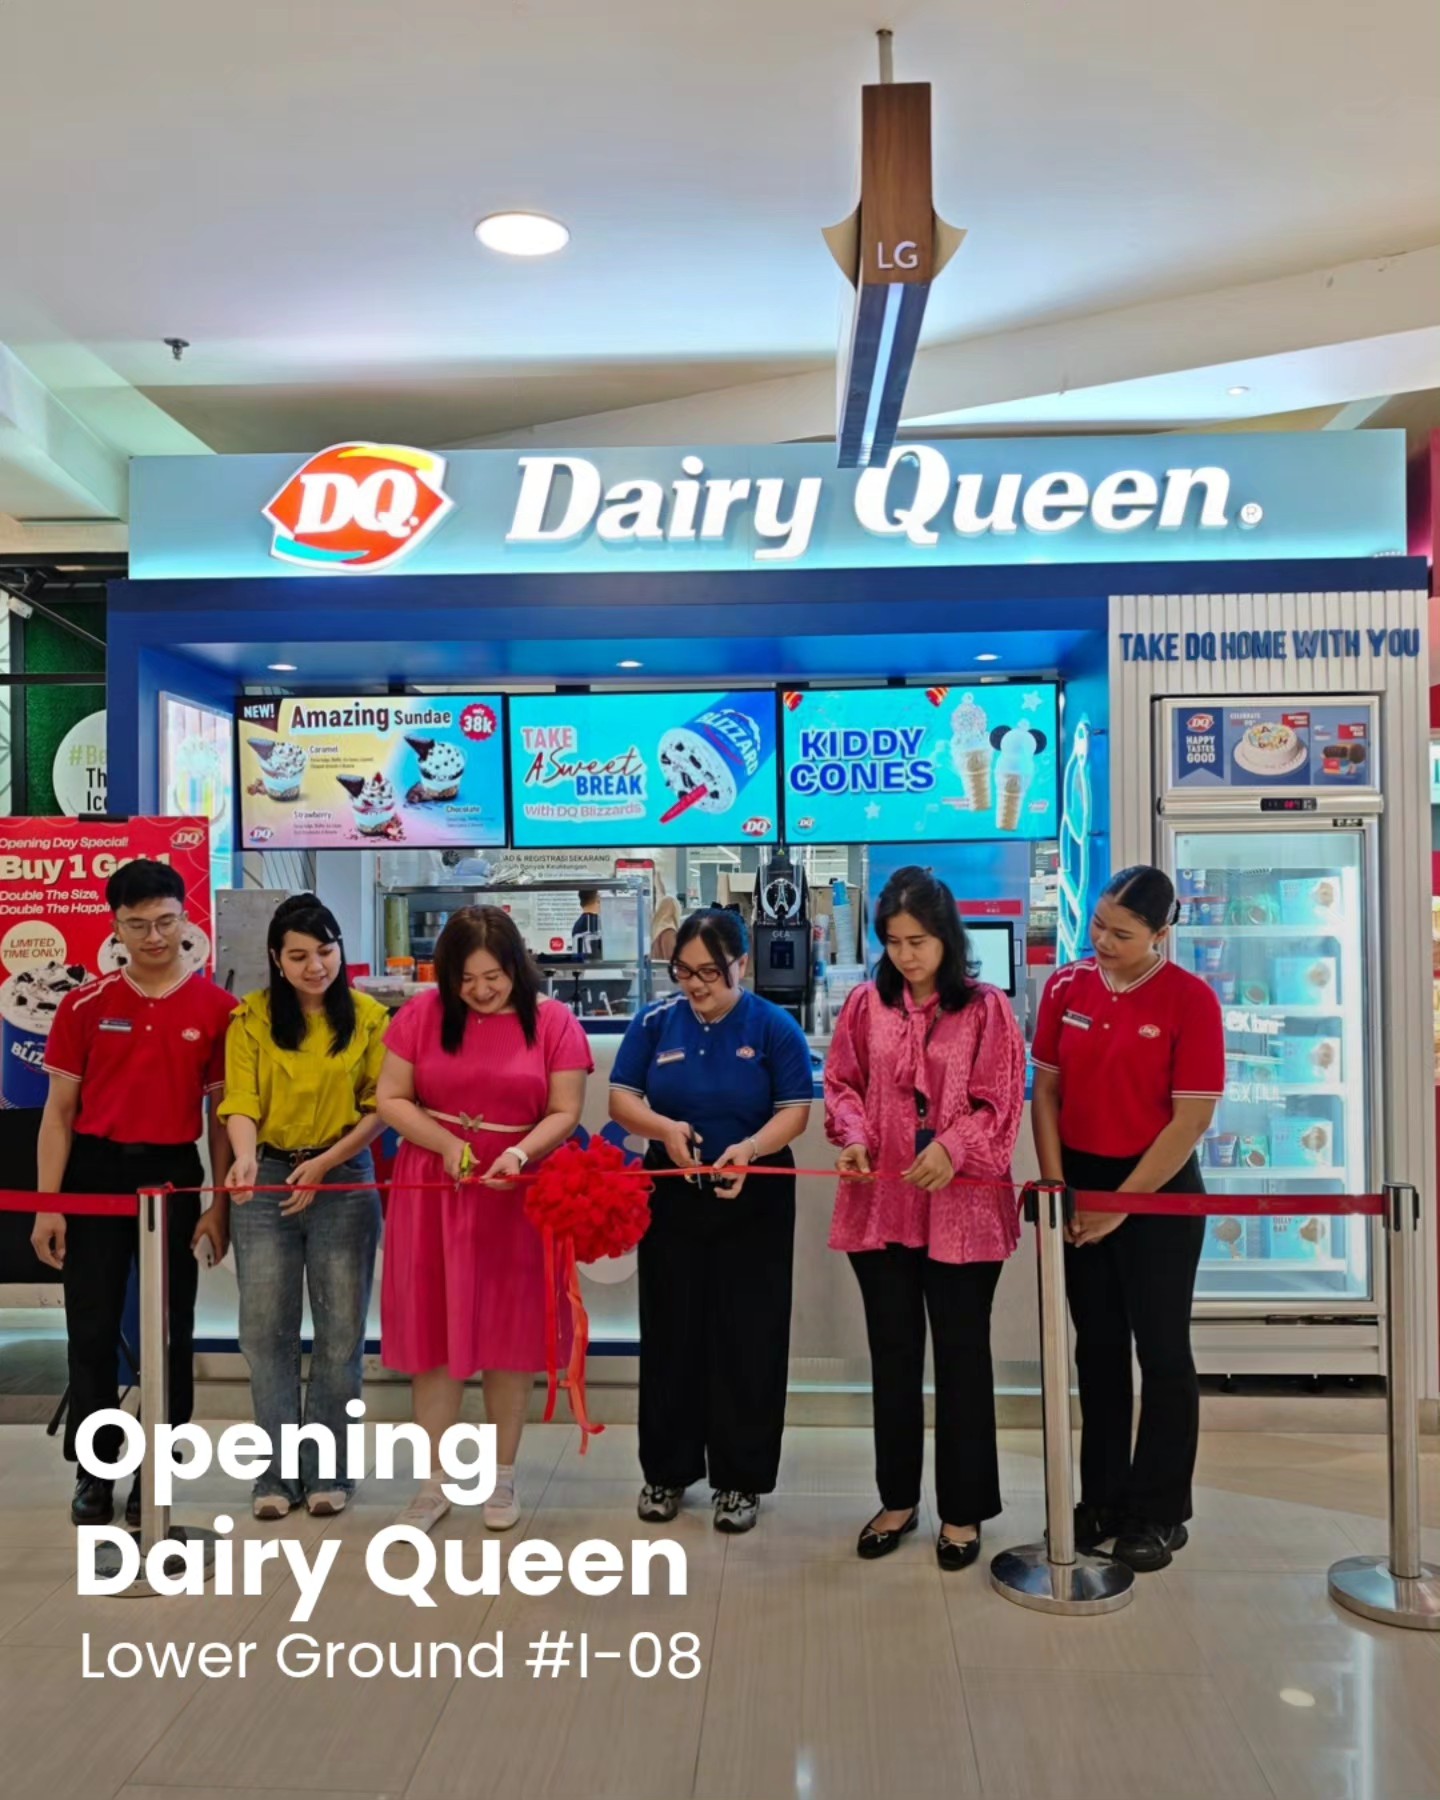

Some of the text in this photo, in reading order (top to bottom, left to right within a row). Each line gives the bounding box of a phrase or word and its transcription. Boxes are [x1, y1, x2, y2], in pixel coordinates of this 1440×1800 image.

[877, 240, 918, 269] LG
[505, 455, 821, 561] Dairy
[855, 444, 1231, 546] Queen
[1119, 628, 1420, 662] TAKE DQ HOME WITH YOU
[244, 704, 275, 718] NEW!
[291, 702, 451, 732] Amazing Sundae
[1191, 718, 1209, 728] DQ
[523, 728, 573, 749] TAKE
[695, 711, 759, 776] BLIZZARD
[801, 728, 925, 758] KIDDY
[1186, 735, 1215, 745] HAPPY
[310, 745, 338, 754] Caramel
[1187, 745, 1215, 753] TASTES
[525, 747, 644, 783] A Sweet
[1186, 753, 1216, 763] GOOD
[790, 760, 935, 791] CONES
[576, 775, 643, 796] BREAK
[88, 791, 107, 811] Ic
[294, 811, 332, 819] Strawberry
[556, 806, 578, 818] DQ
[580, 803, 642, 817] Blizzards
[747, 821, 768, 834] DQ
[0, 836, 129, 850] Opening Day Special!
[524, 854, 567, 862] REGISTRASI
[569, 854, 610, 862] SEKARANG
[0, 855, 65, 885] Buy
[69, 854, 87, 879] 1
[0, 889, 100, 901] Double The Size,
[0, 904, 44, 915] Double
[46, 903, 69, 914] The
[10, 938, 56, 948] LIMITED
[3, 948, 65, 959] TIME ONLY!
